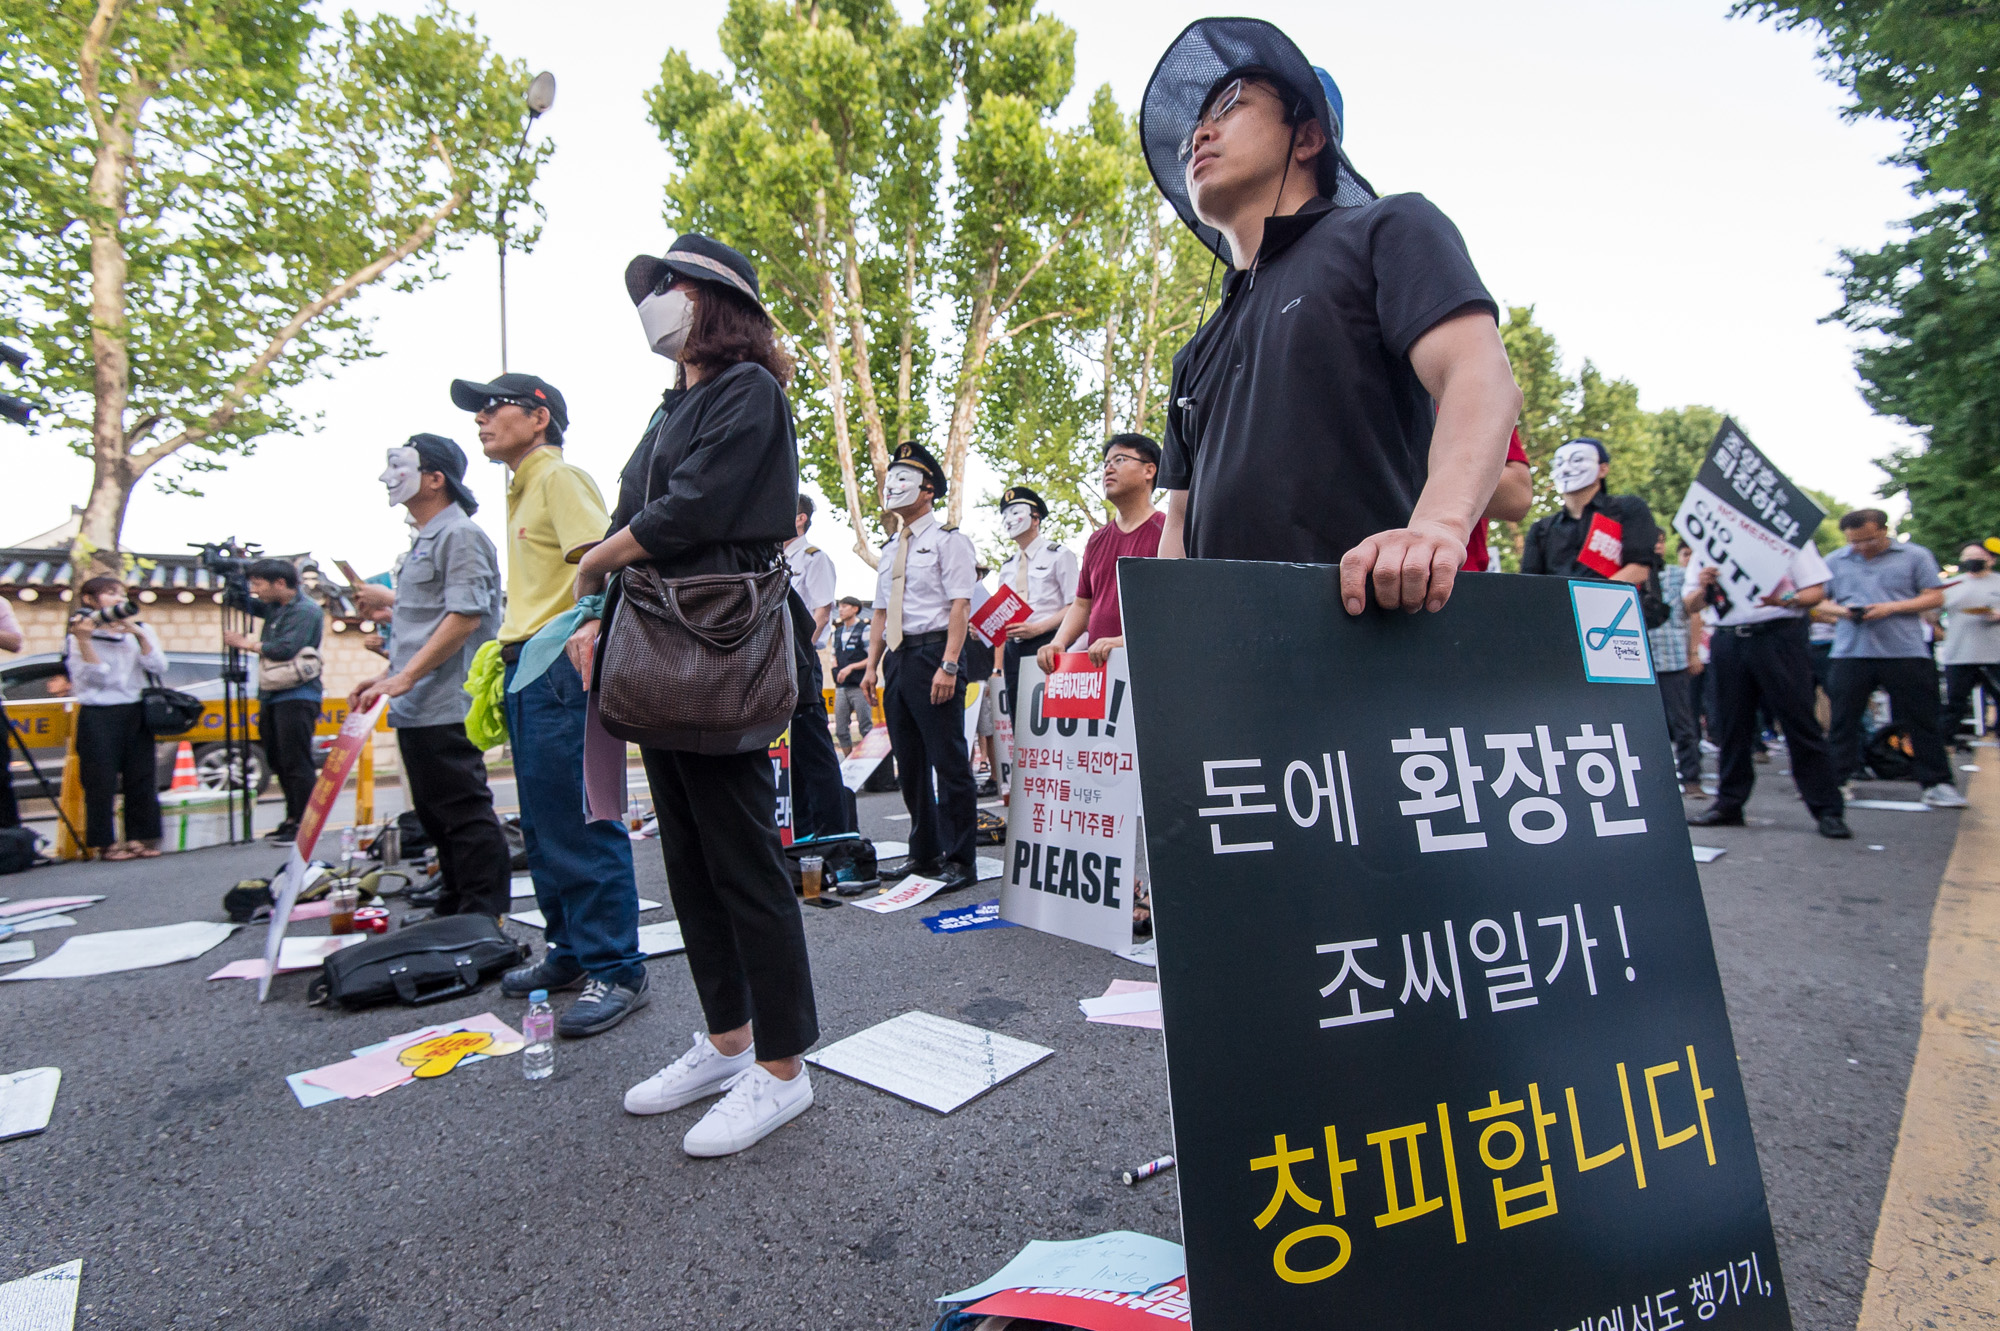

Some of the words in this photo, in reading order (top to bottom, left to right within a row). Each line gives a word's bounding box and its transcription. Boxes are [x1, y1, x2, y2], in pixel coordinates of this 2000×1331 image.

[1686, 514, 1761, 602] OUT!
[1695, 500, 1733, 544] CHO
[1077, 750, 1133, 775] 퇴진하고
[1198, 750, 1359, 855] 돈에
[1390, 722, 1648, 854] 환장한
[1011, 839, 1122, 909] PLEASE
[1315, 903, 1636, 1029] 조씨일가!
[1249, 1046, 1717, 1284] 창피합니다
[1688, 1251, 1772, 1321] 챙기기,
